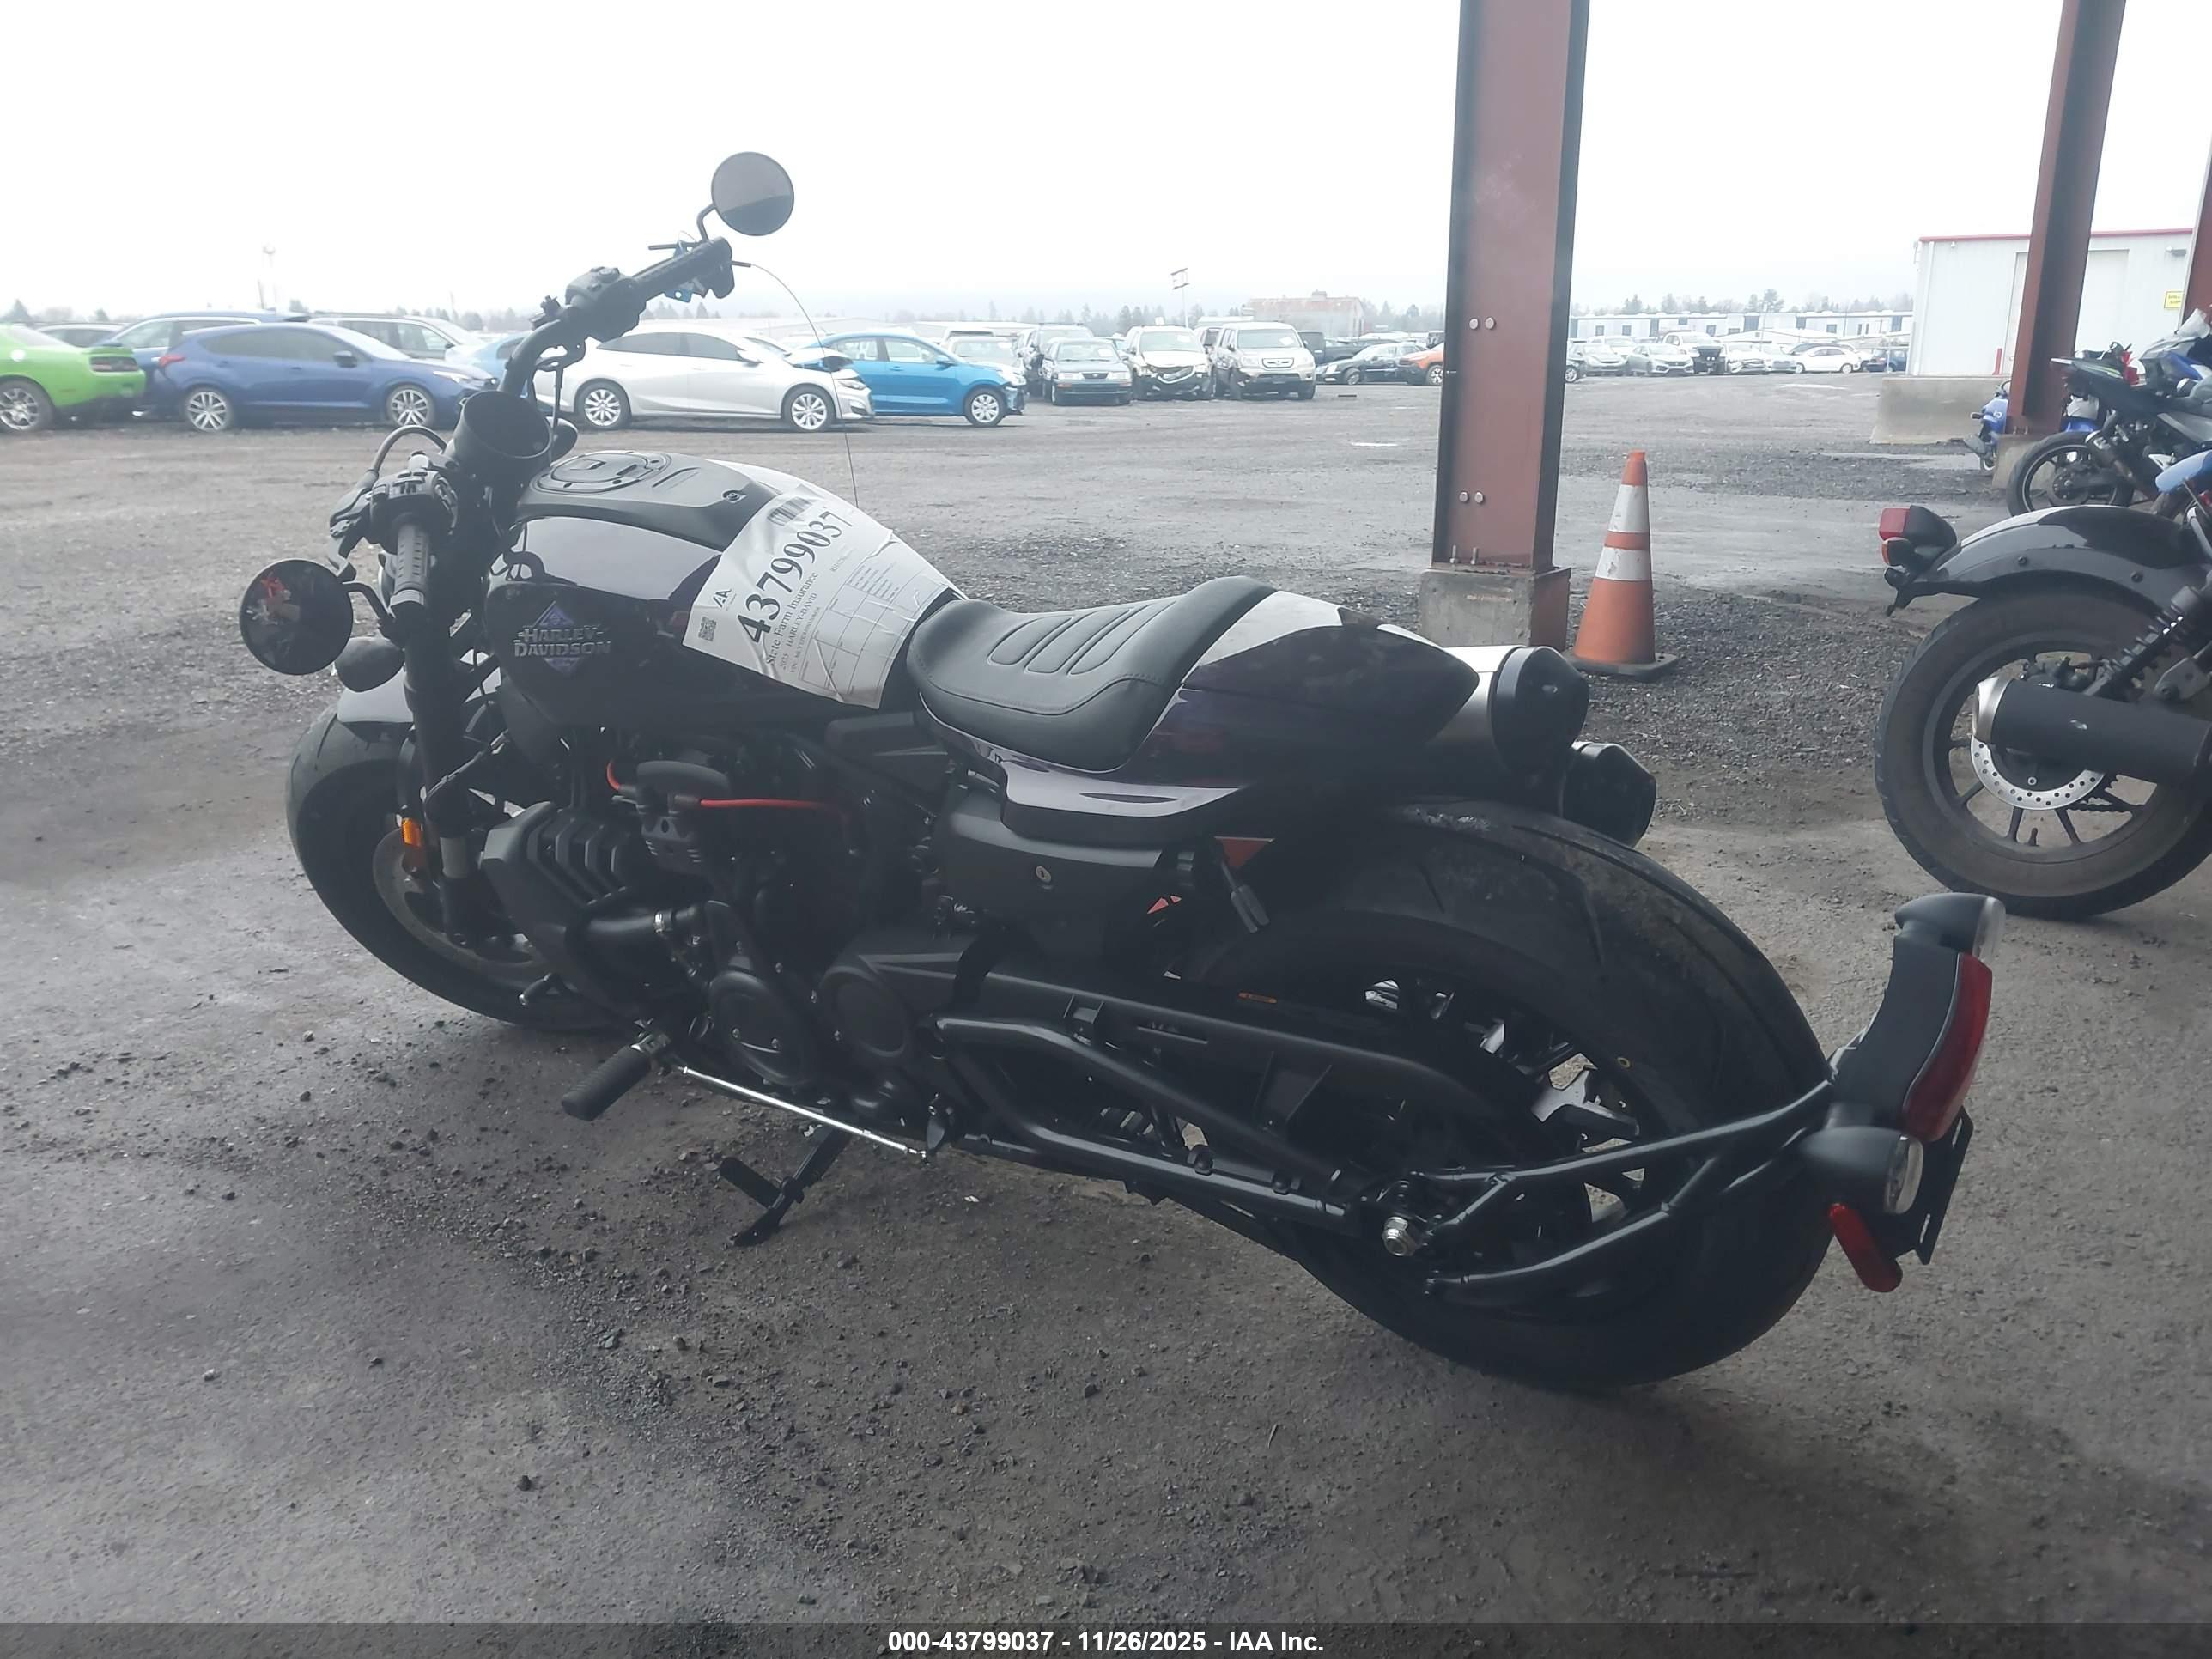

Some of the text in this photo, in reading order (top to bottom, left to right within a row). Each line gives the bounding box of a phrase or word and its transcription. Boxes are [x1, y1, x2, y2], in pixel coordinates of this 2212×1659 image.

[737, 511, 853, 643] 43799037
[774, 611, 793, 637] Farm
[787, 572, 819, 611] Insurance
[514, 641, 612, 658] DAVIDSON
